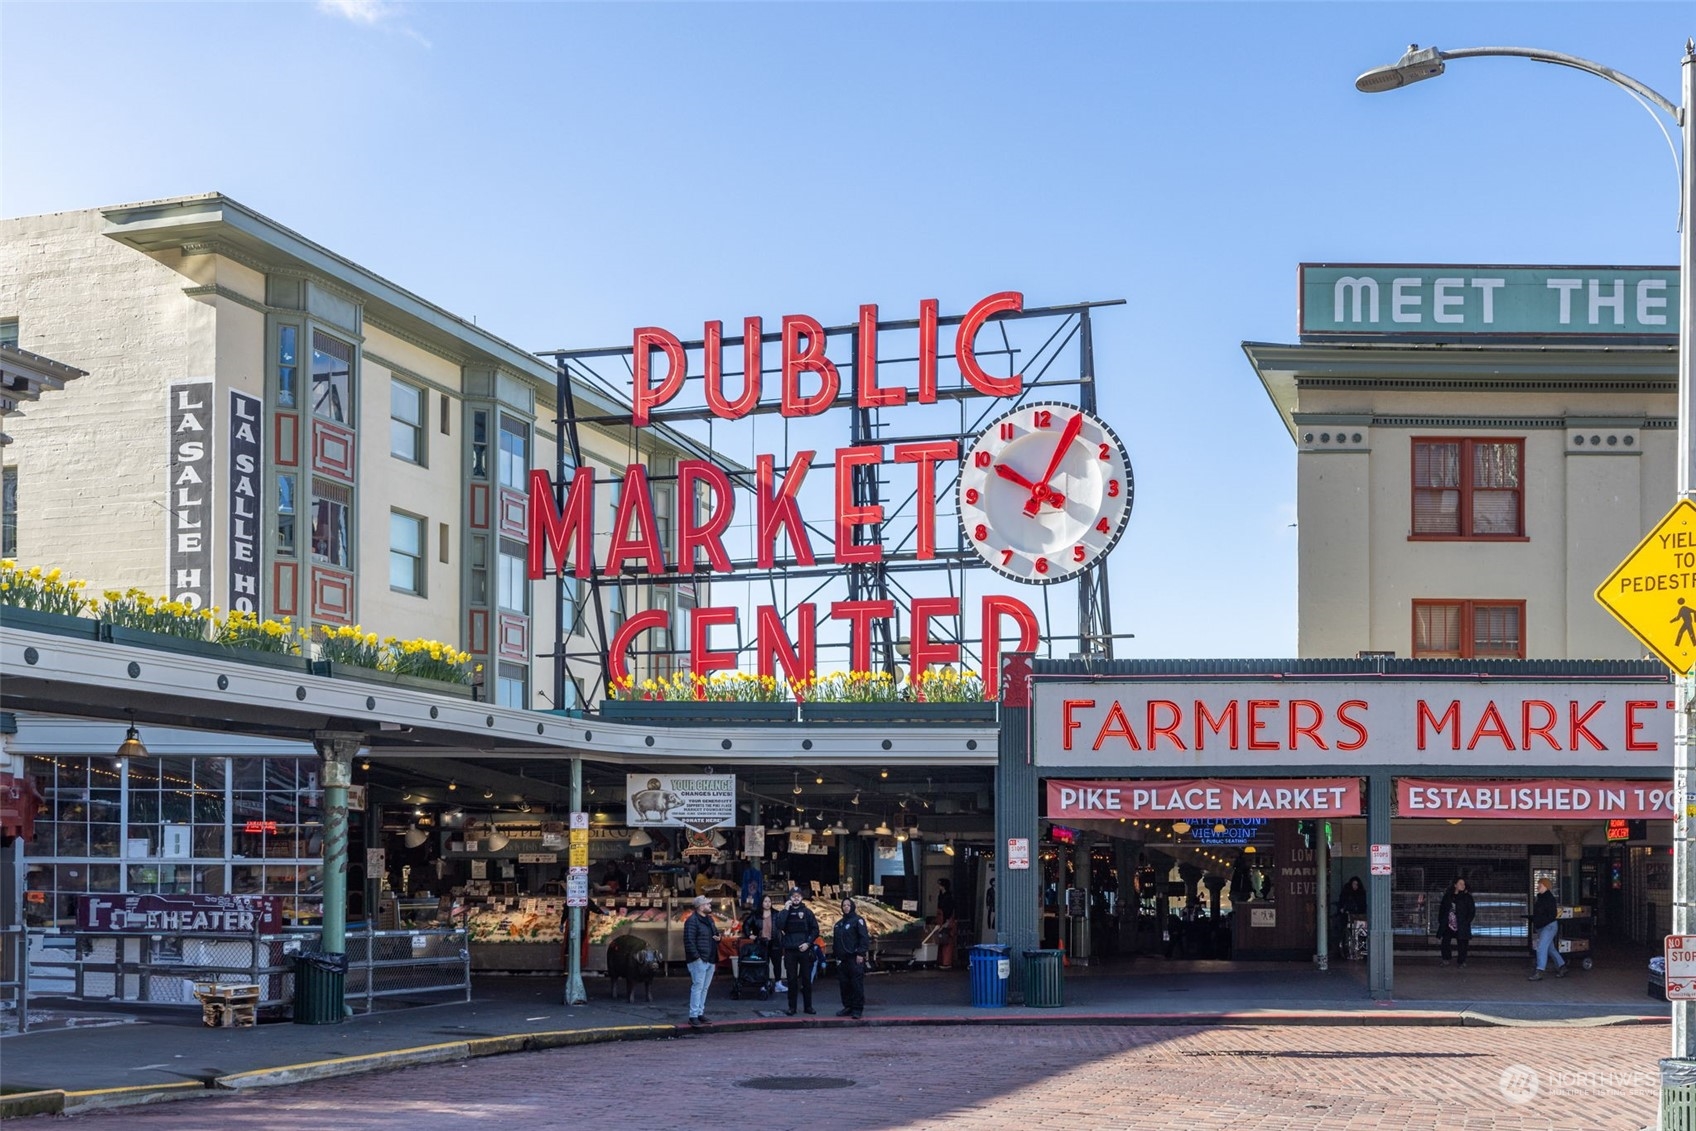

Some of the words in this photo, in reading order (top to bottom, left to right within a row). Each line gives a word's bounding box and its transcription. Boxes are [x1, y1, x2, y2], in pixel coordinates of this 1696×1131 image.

[1334, 276, 1505, 324] MEET
[1546, 277, 1667, 325] THE
[631, 291, 1024, 427] PUBLIC
[175, 390, 204, 433] LA
[235, 397, 256, 444] LA
[1034, 410, 1052, 428] 12
[1000, 422, 1013, 441] 11
[975, 450, 991, 468] 10
[1098, 443, 1111, 461] 2
[175, 441, 205, 553] SALLE
[966, 487, 979, 505] 9
[1107, 479, 1119, 498] 3
[234, 454, 256, 563] SALLE
[528, 440, 959, 581] MARKET
[974, 523, 988, 541] 8
[1095, 517, 1110, 534] 4
[1000, 549, 1014, 566] 7
[1073, 545, 1085, 563] 5
[1674, 552, 1695, 568] TO
[1035, 557, 1049, 574] 6
[608, 594, 1039, 702] CENTER
[1062, 699, 1370, 752] FARMERS
[1416, 699, 1675, 752] MARKE
[670, 779, 694, 791] YOUR
[695, 779, 733, 791] CHANGE
[1060, 788, 1121, 811] PIKE
[1133, 787, 1222, 812] PLACE
[1232, 786, 1347, 811] MARKET
[1409, 787, 1592, 812] ESTABLISHED
[1598, 788, 1626, 811] IN
[1191, 827, 1258, 839] VIEWPOINT
[1668, 938, 1681, 948] NO
